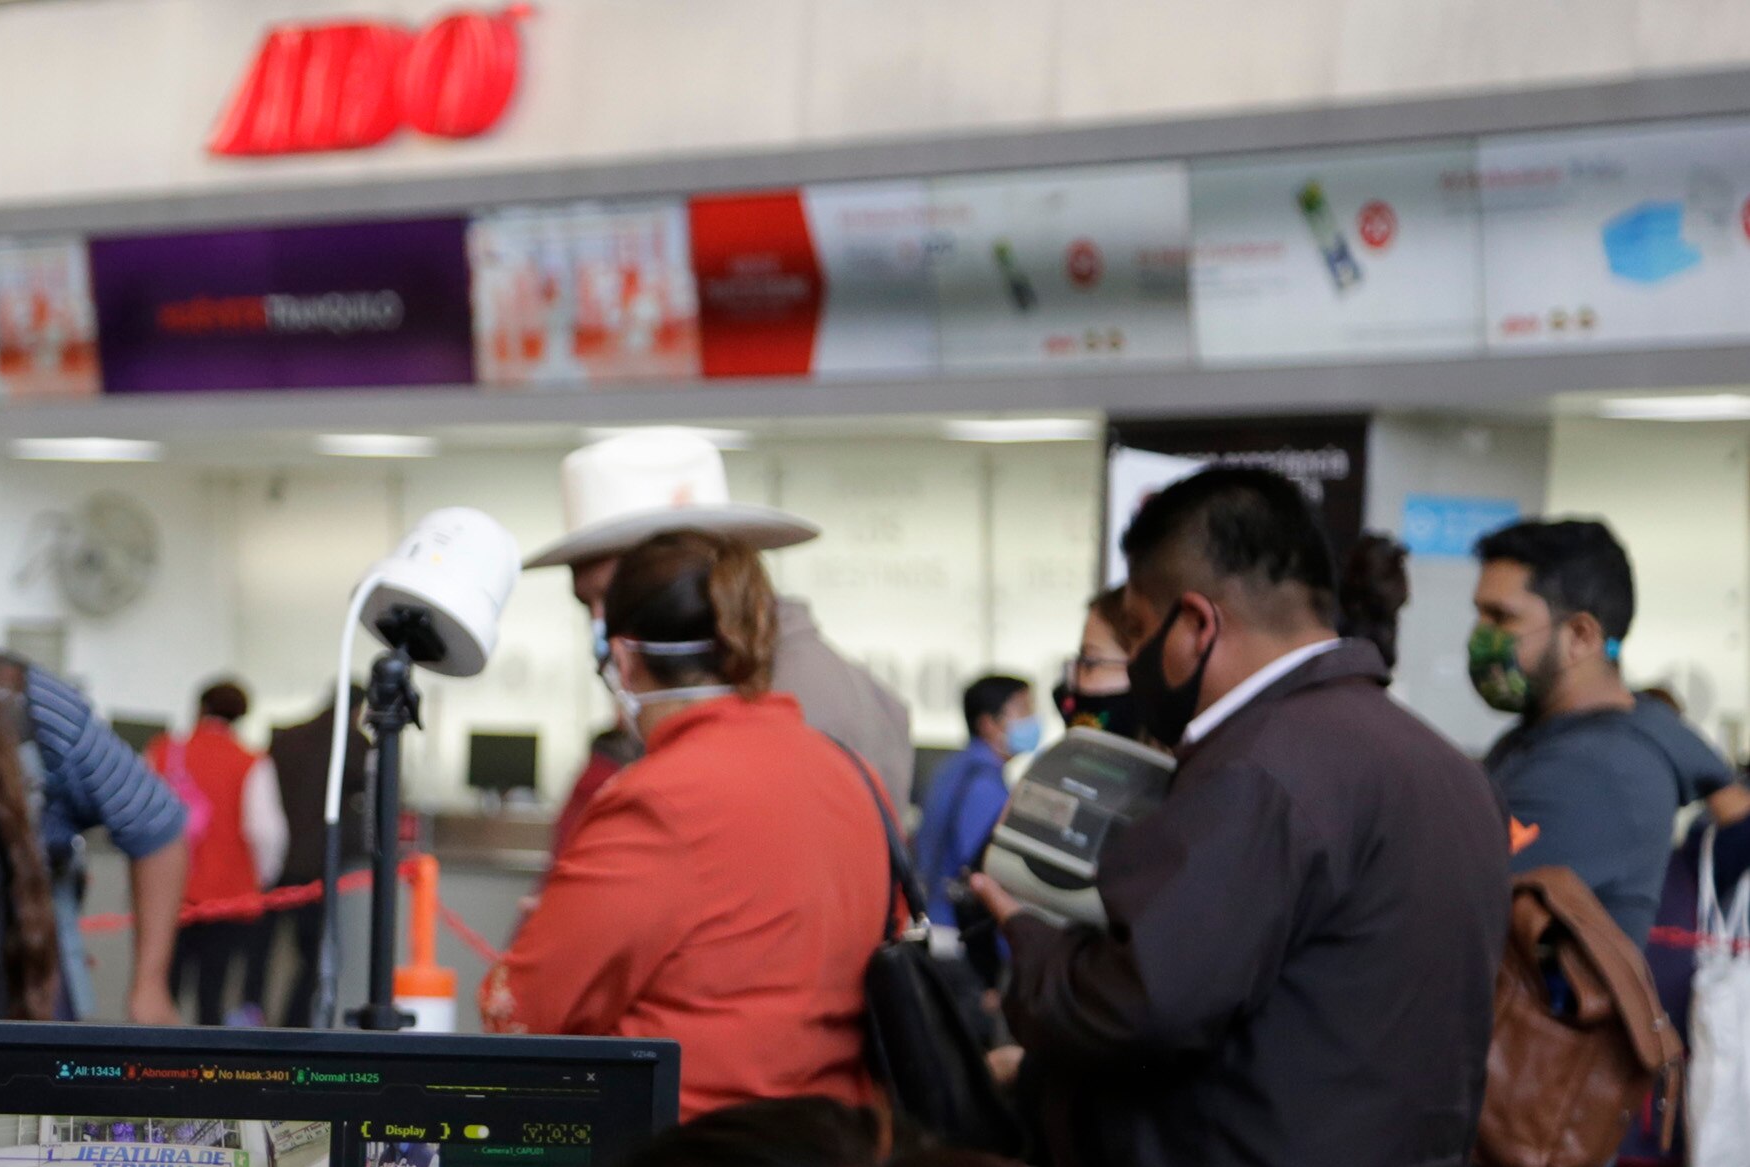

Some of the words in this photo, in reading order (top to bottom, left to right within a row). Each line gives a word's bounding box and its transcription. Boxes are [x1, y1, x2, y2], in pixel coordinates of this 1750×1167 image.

[74, 1065, 122, 1077] All:13434
[141, 1067, 199, 1078] Abnormal:9
[218, 1069, 234, 1080] No
[235, 1069, 291, 1081] Mask:3401
[310, 1072, 380, 1084] Normal:13425
[385, 1125, 426, 1138] Display
[76, 1145, 192, 1163] JEFATURA
[198, 1150, 227, 1165] DE
